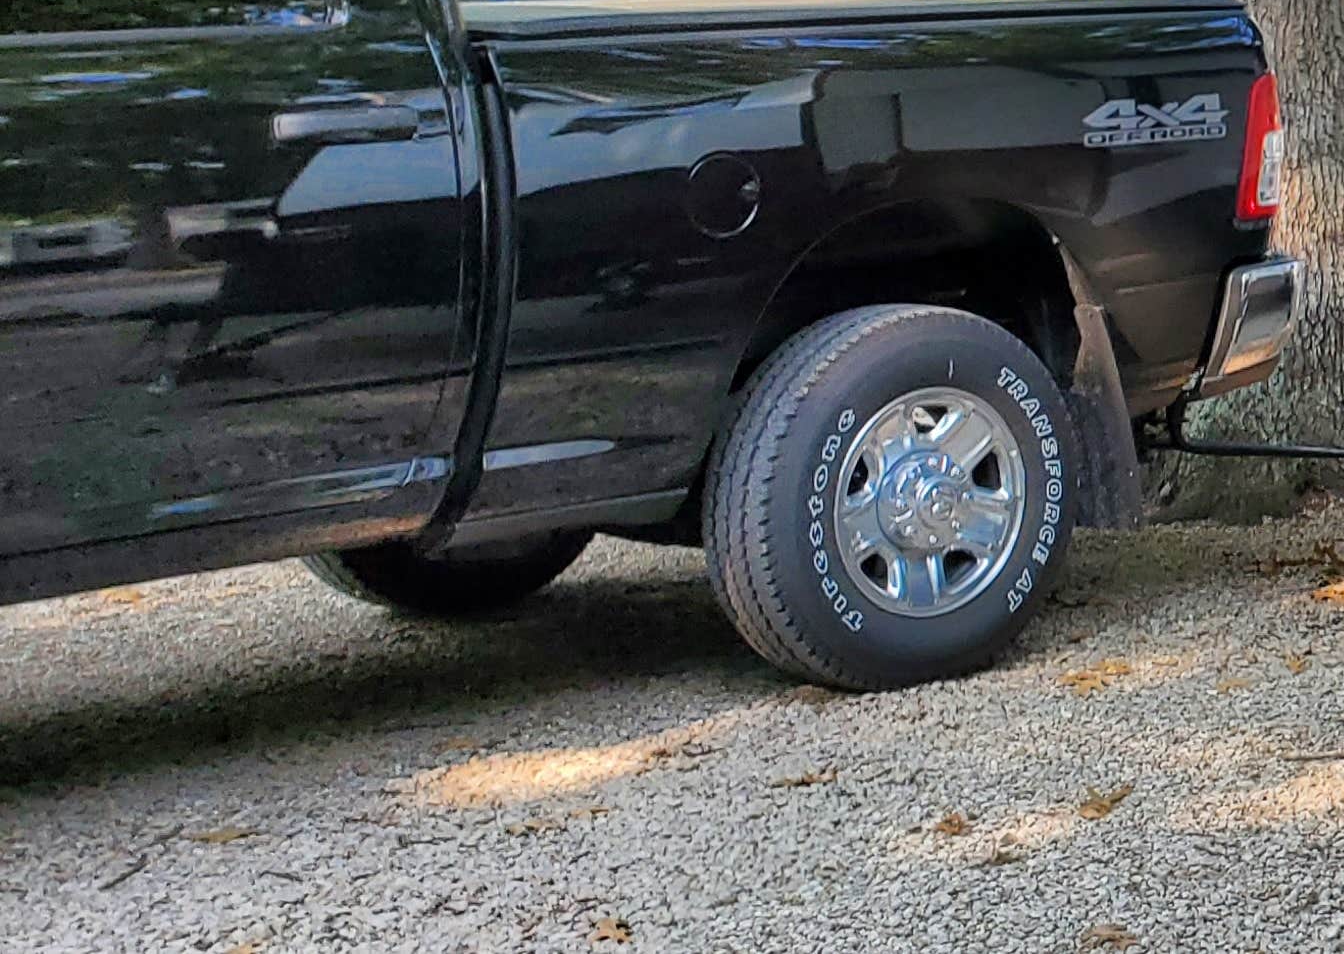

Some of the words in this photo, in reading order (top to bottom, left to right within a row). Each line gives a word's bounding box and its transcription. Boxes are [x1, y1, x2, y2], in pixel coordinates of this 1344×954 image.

[1082, 93, 1230, 130] 4x4
[808, 408, 864, 632] Firestone
[997, 366, 1063, 567] TRANSFORCE
[1007, 567, 1033, 613] AT
